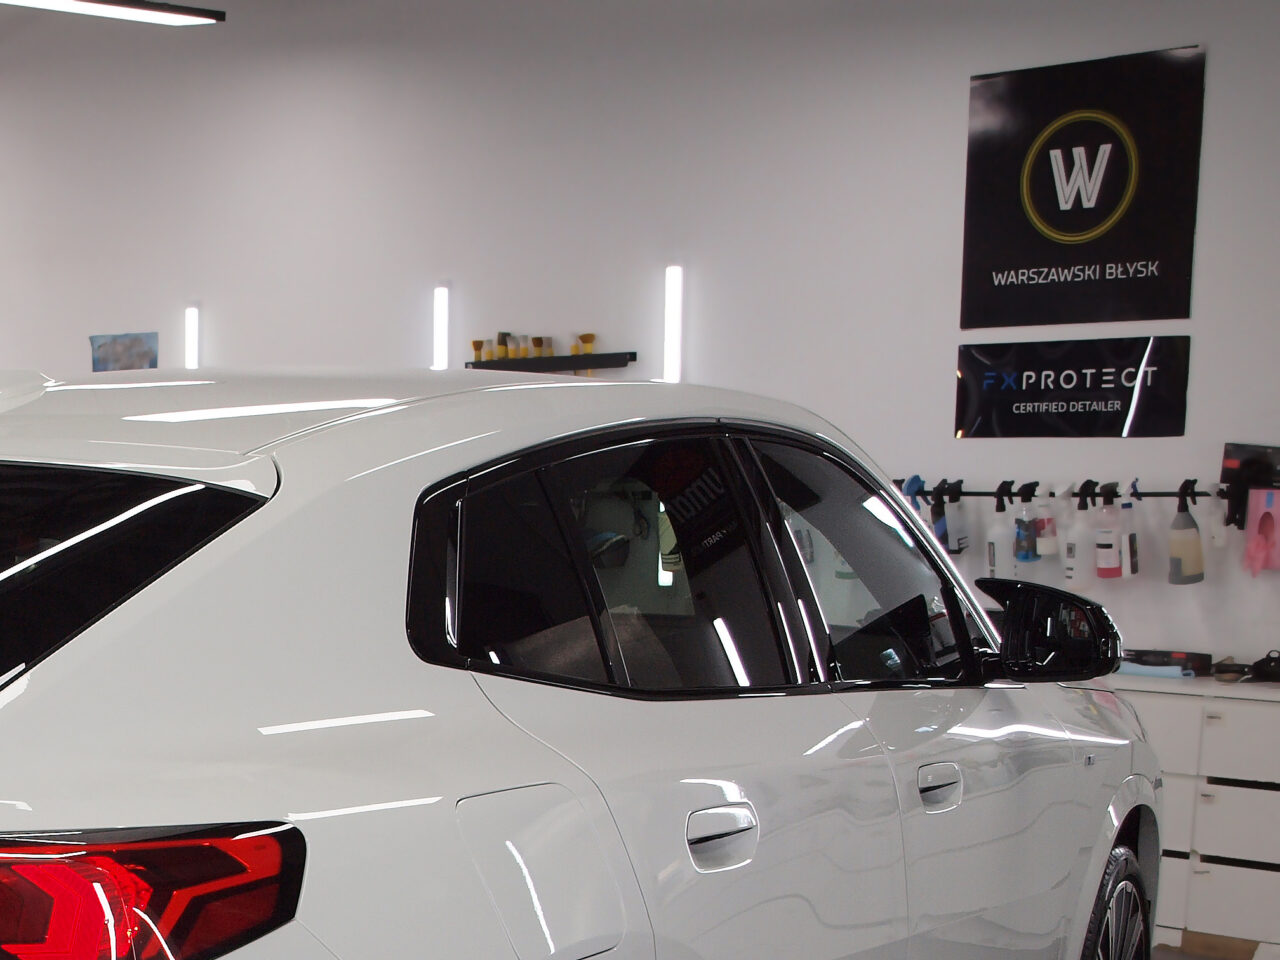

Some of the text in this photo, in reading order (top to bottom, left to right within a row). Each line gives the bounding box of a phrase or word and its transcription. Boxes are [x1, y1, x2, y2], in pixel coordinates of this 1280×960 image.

[1049, 143, 1112, 211] W
[992, 260, 1160, 286] WARSZAWSKI BŁYSK
[1012, 399, 1121, 414] CERTIFIED DETAILER
